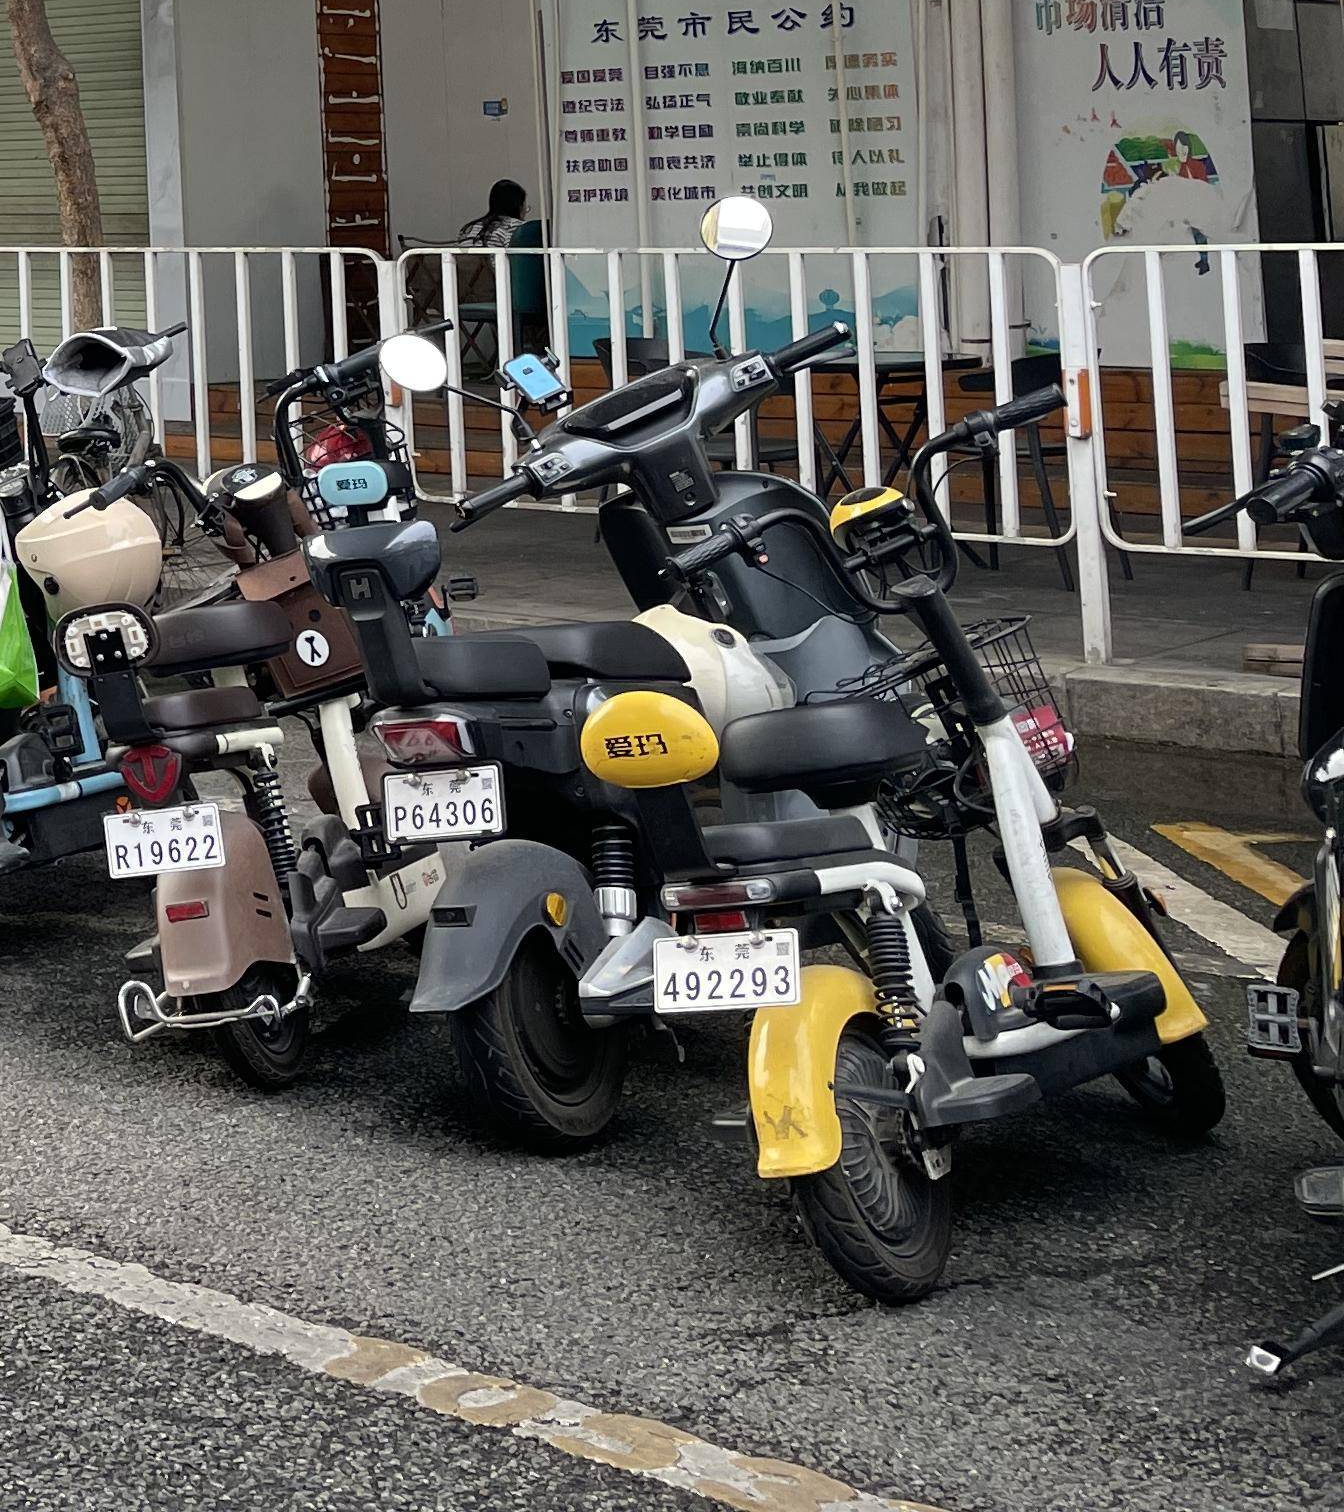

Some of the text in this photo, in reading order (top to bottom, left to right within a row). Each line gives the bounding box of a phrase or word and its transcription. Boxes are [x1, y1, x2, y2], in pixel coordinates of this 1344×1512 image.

[590, 1, 856, 45] 东莞市民公约
[644, 62, 711, 81] 自强不息
[731, 57, 802, 76] 海纳百川
[1091, 37, 1228, 92] 人人有责
[562, 97, 626, 114] 遵纪守法
[645, 92, 713, 110] 弘扬正气
[734, 88, 805, 107] 敬业奉献
[735, 119, 807, 138] 崇尚科学
[737, 151, 809, 169] 举止得体
[567, 186, 630, 204] 爱护环境
[650, 184, 717, 202] 美化城市
[740, 183, 809, 200] 共创文明
[334, 478, 367, 492] 爱玛
[394, 798, 495, 832] P64306
[115, 834, 218, 870] R19622
[663, 965, 791, 1003] 492293
